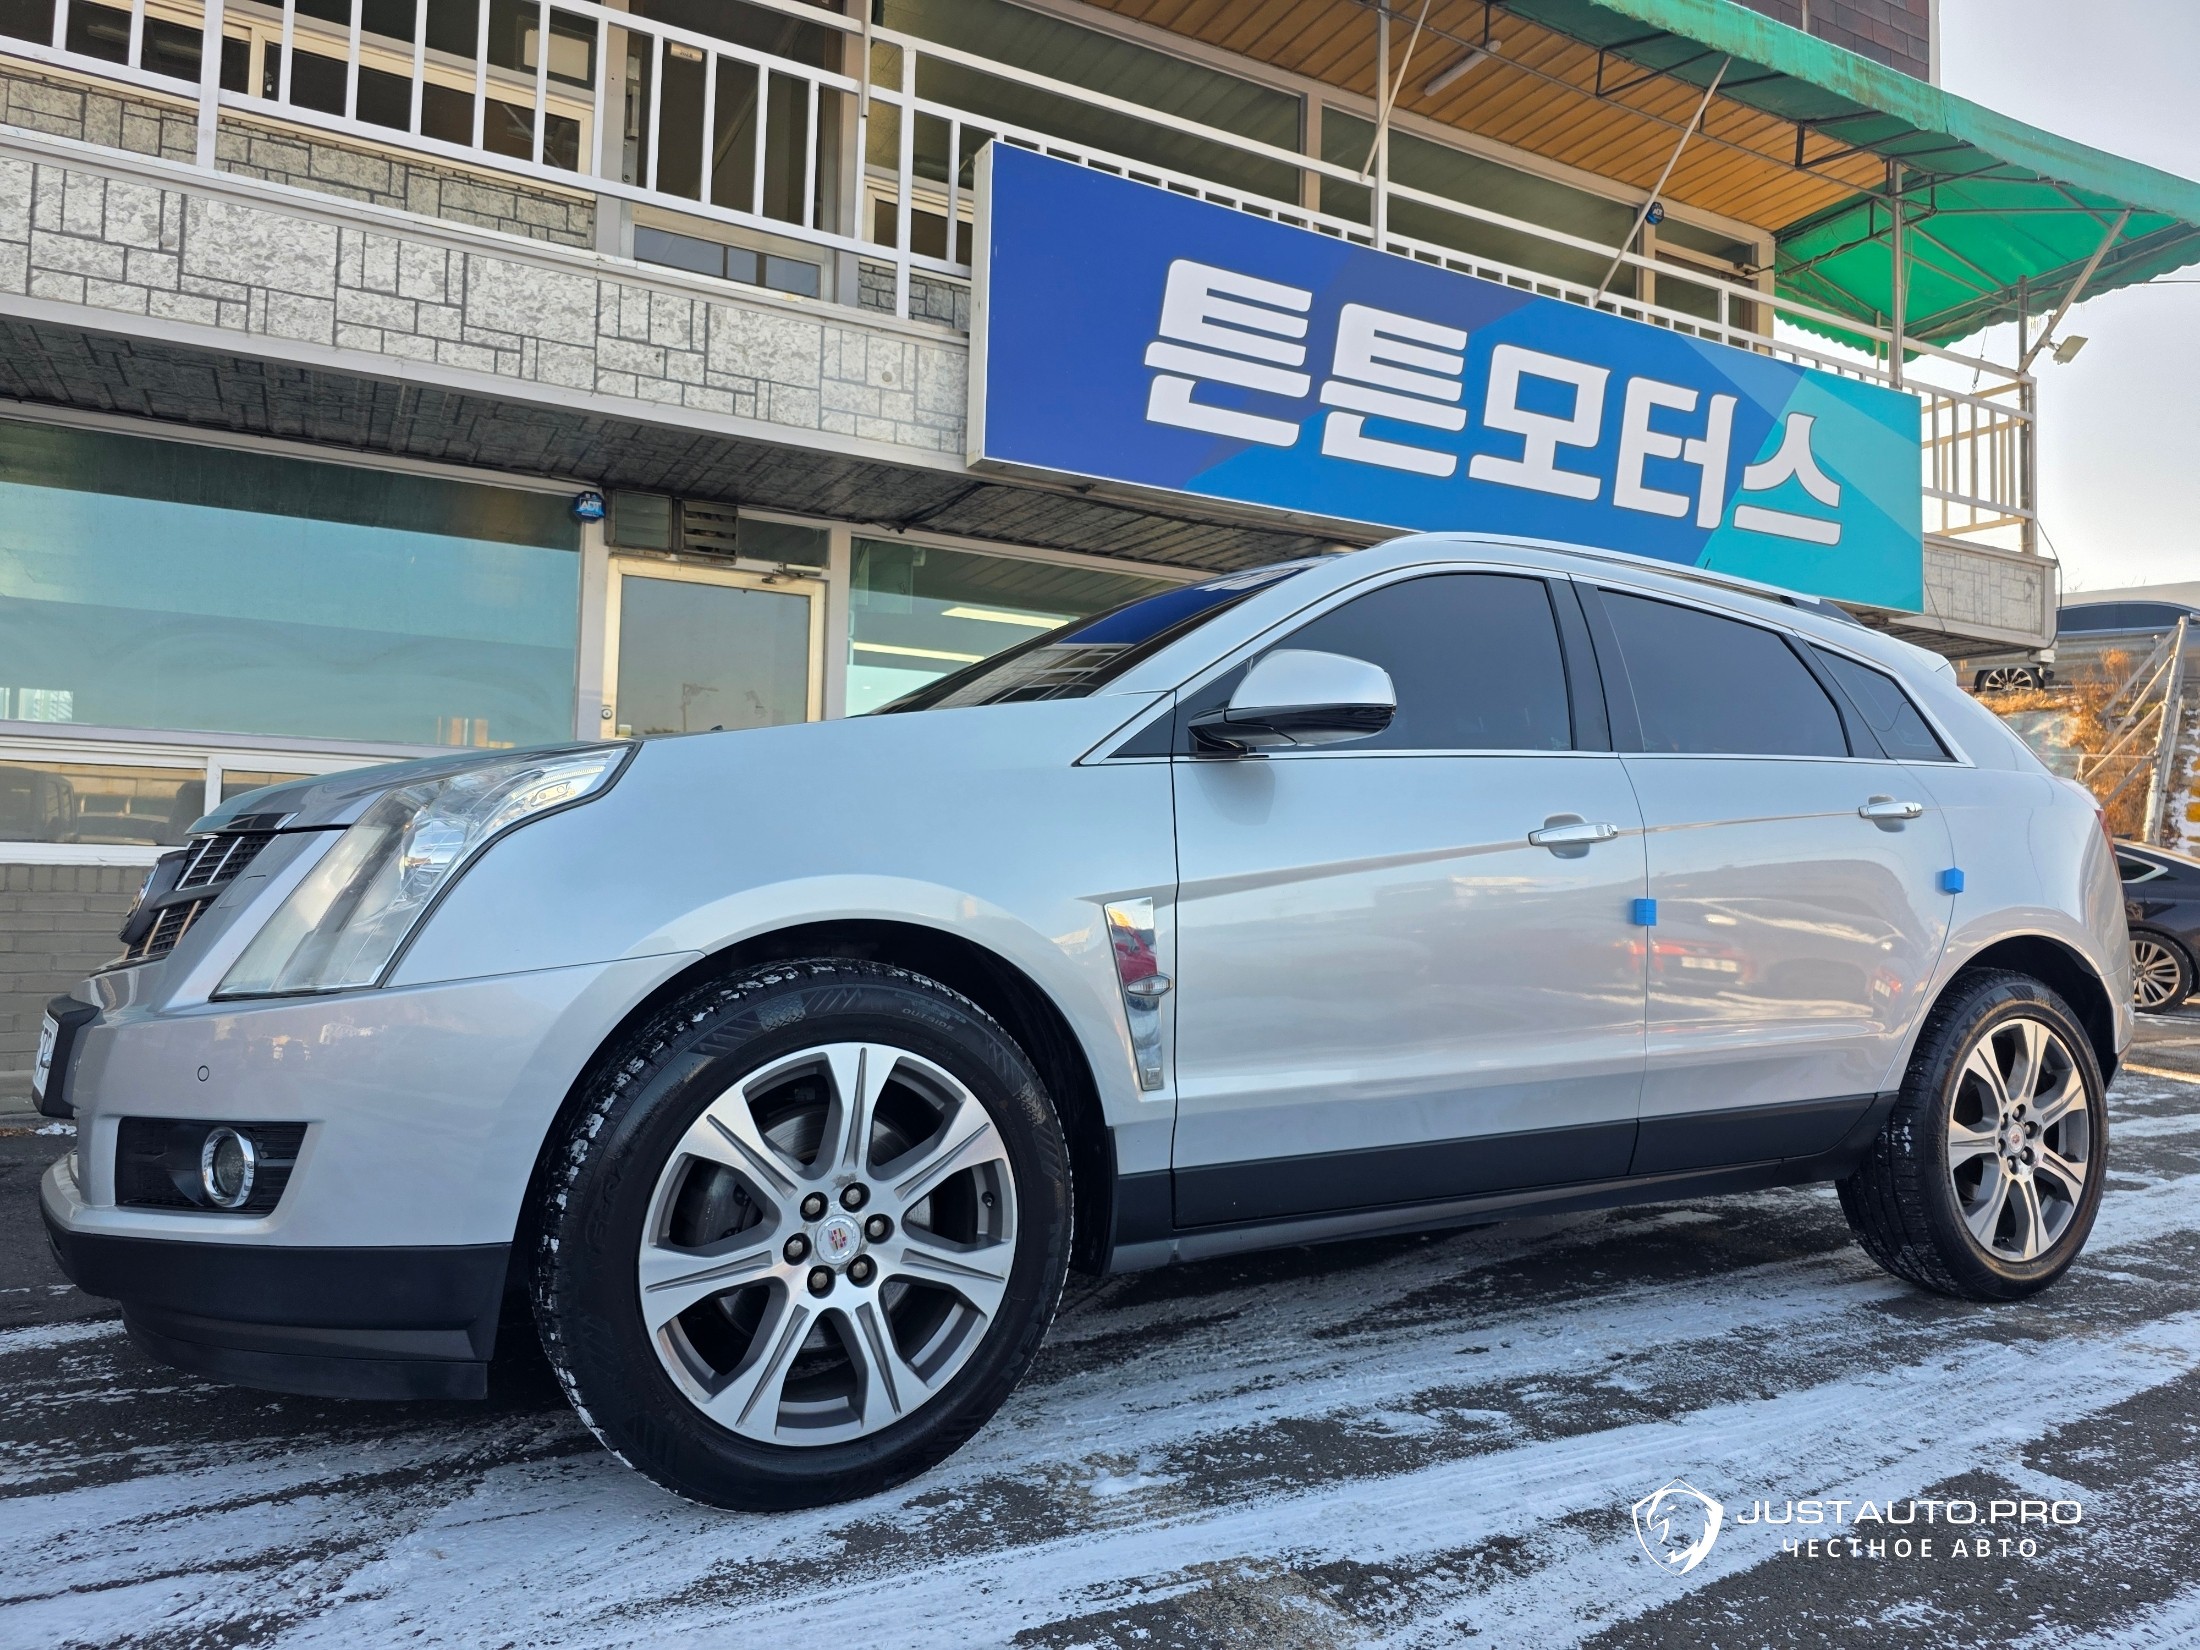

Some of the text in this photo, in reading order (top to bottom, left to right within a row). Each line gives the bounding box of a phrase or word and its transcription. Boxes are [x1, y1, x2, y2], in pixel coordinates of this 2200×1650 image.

[1145, 259, 1841, 545] 튼튼모터스
[580, 500, 602, 511] ADT
[901, 1007, 955, 1032] OUTSIDE
[1943, 996, 1996, 1067] NEXEN
